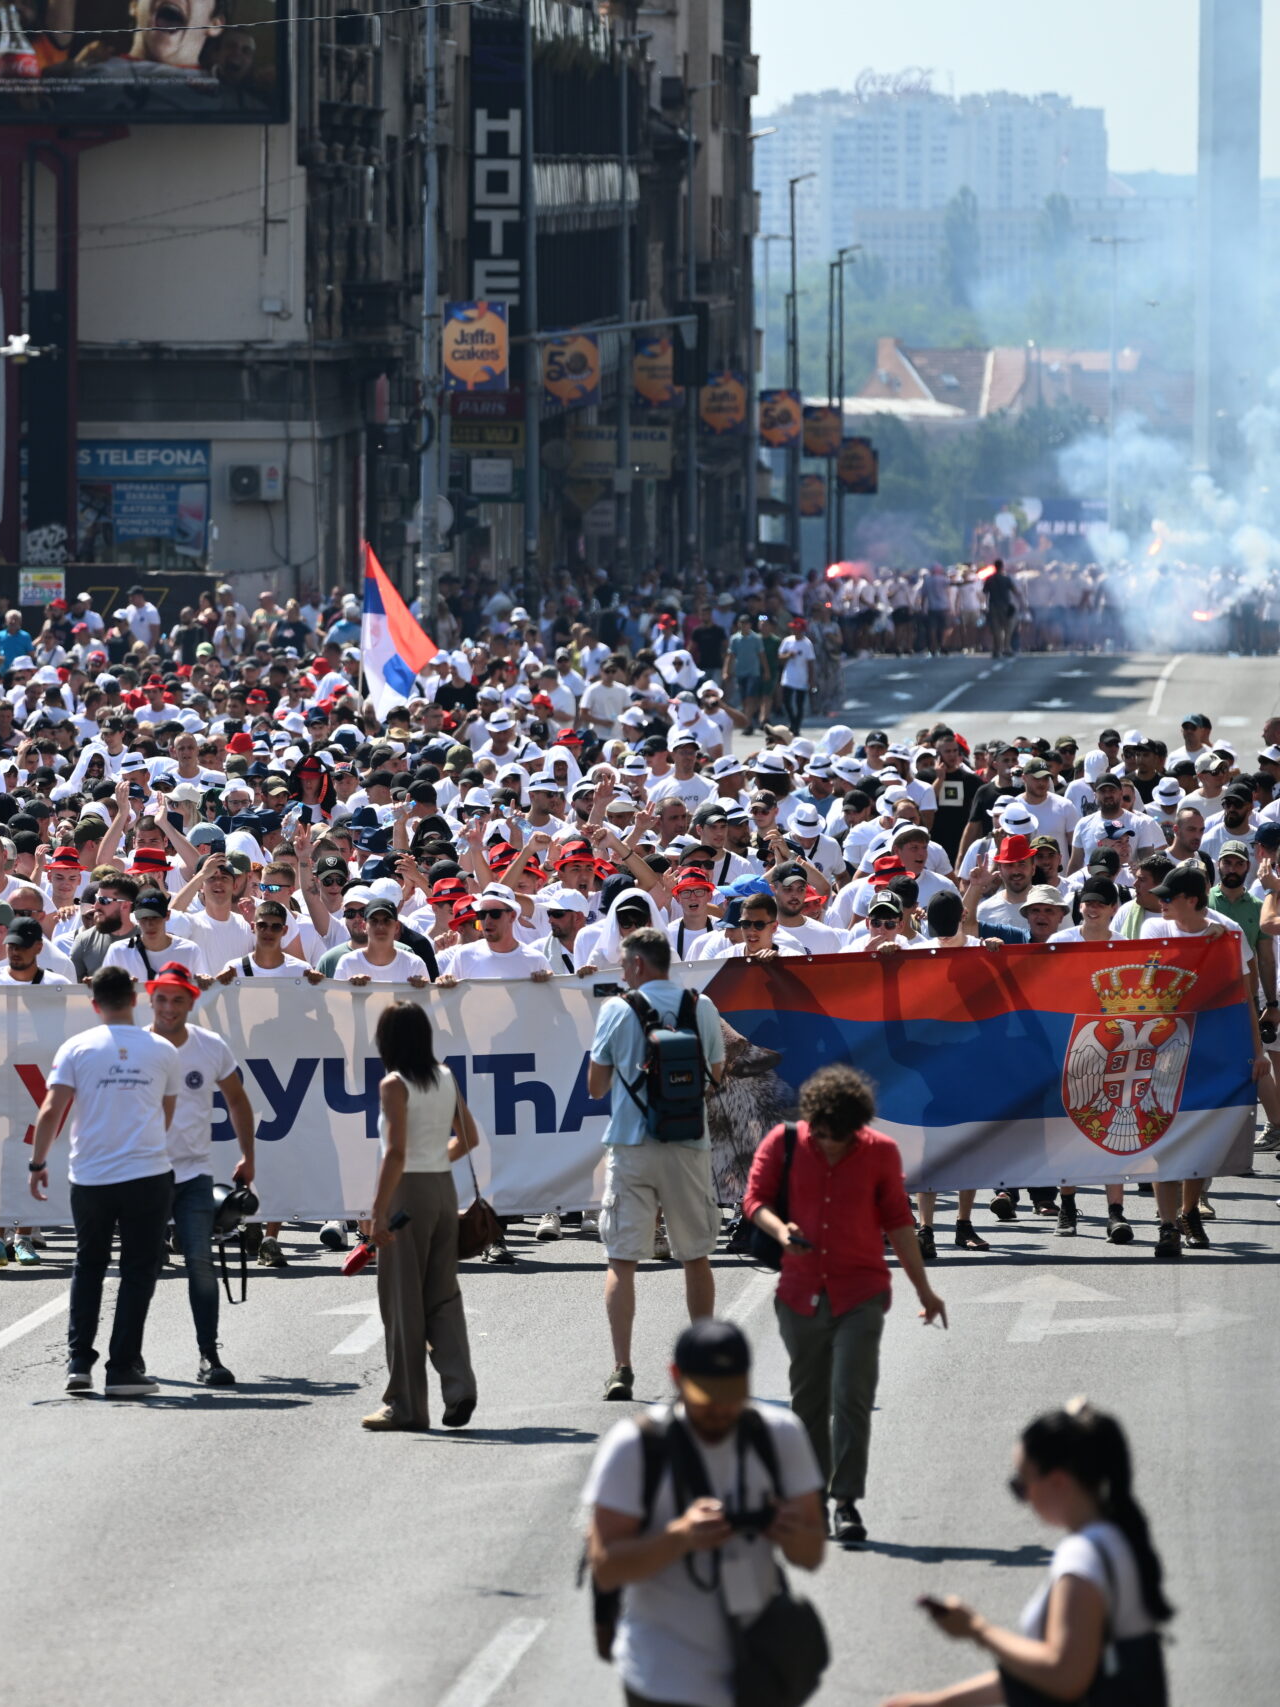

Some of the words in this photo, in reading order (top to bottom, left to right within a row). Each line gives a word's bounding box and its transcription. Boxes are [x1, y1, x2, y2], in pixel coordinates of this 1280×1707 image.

[454, 329, 496, 345] Jaffa
[452, 345, 500, 360] cakes
[96, 449, 207, 465] TELEFONA
